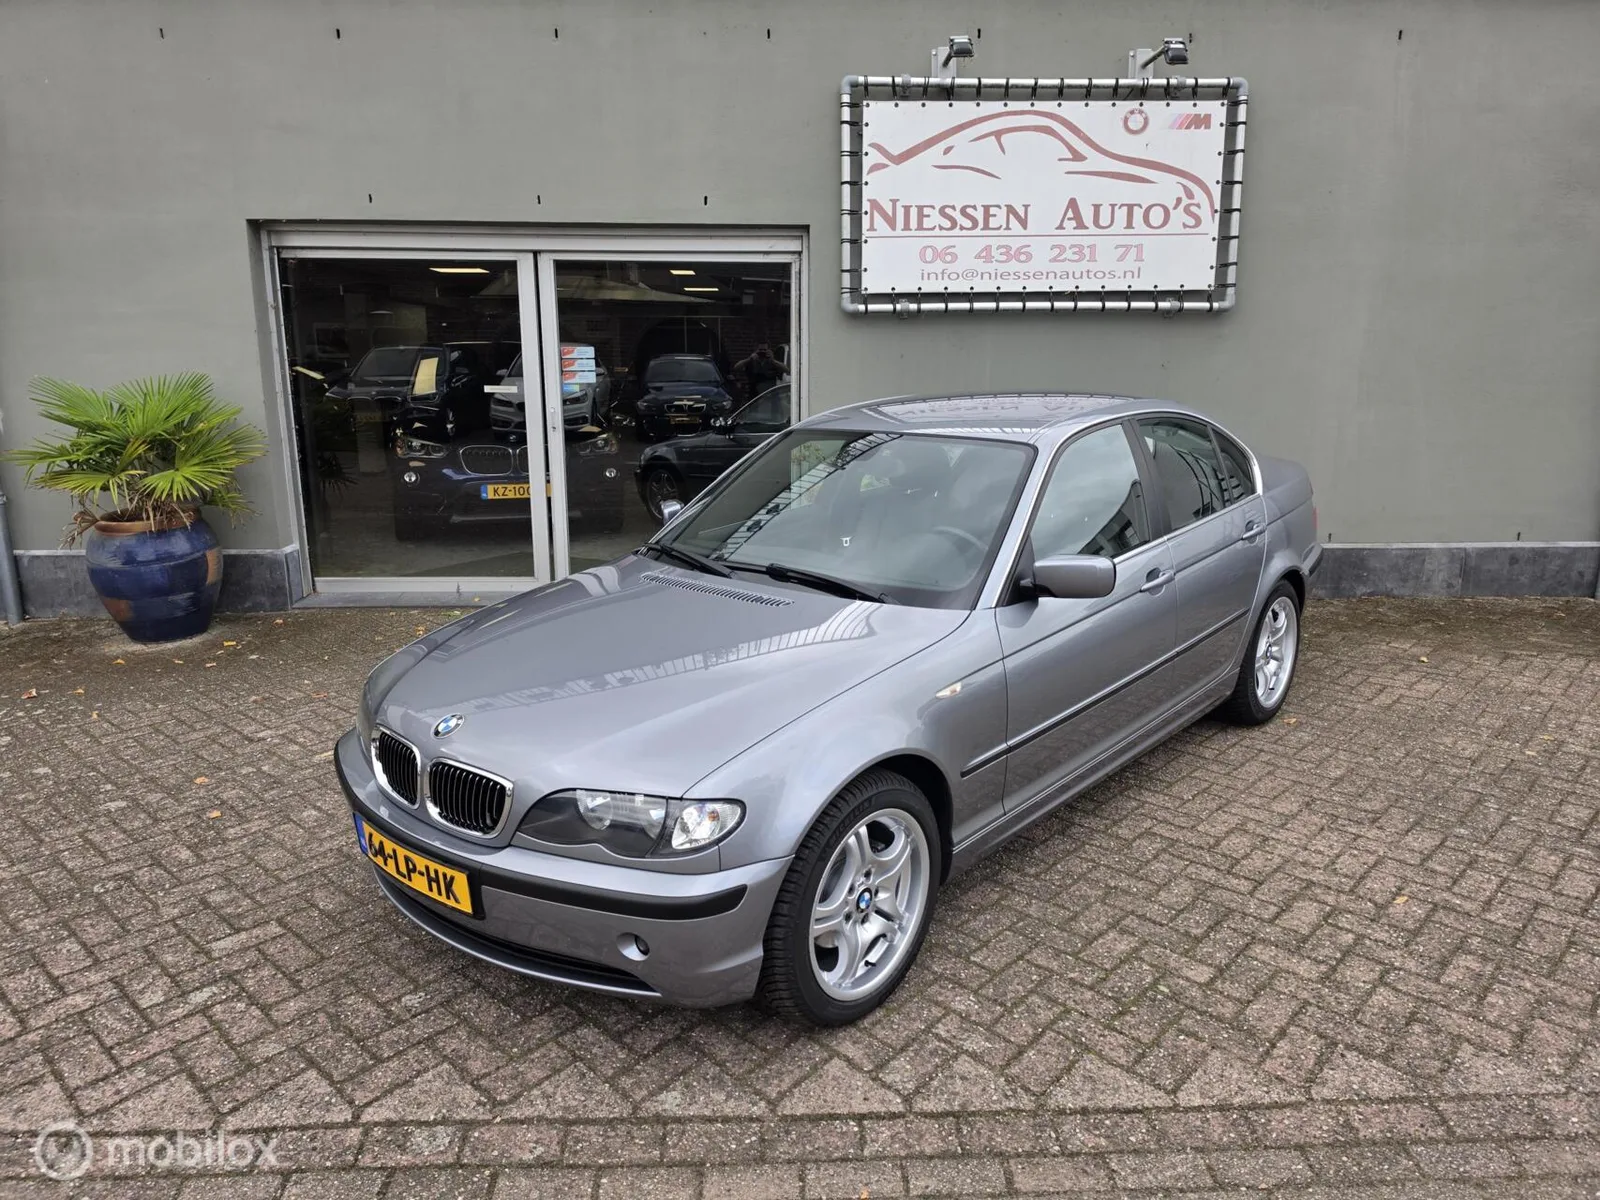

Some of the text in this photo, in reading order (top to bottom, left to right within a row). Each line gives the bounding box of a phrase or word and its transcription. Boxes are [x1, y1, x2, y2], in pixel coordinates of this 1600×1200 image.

[867, 197, 1202, 232] NIESSEN AUTO'S
[919, 244, 1144, 264] 06 436 231 71
[921, 266, 1141, 281] info@niessenautos.nl
[368, 832, 461, 904] 64-LP-HK
